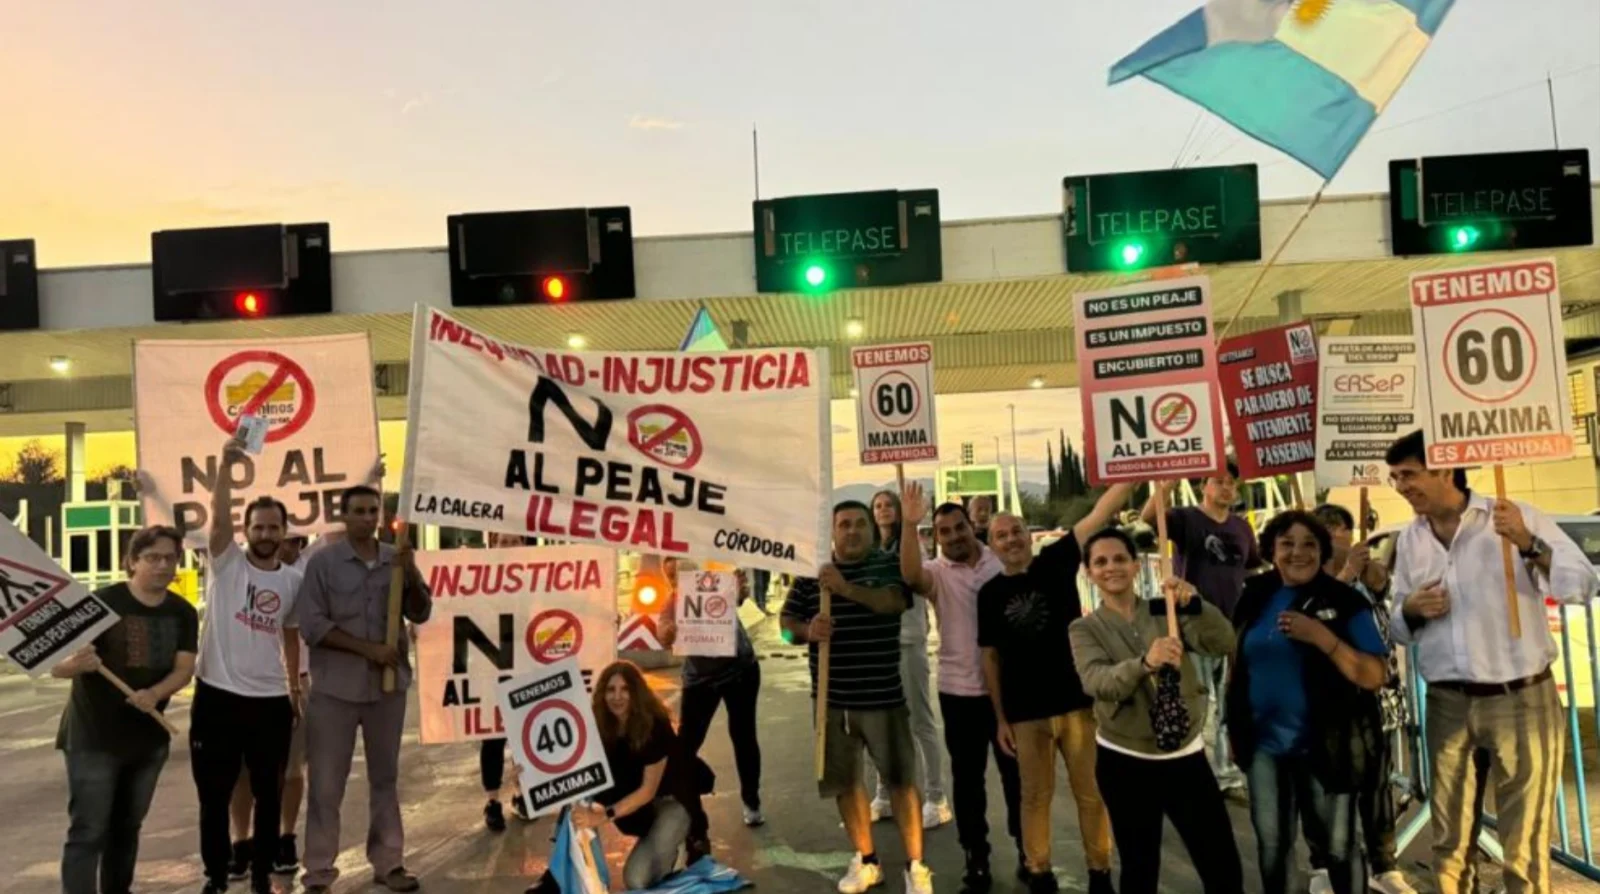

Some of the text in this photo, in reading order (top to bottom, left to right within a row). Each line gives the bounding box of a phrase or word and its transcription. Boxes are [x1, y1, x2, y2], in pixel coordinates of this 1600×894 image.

[1430, 187, 1553, 216] TELEPASE
[1096, 206, 1217, 236] TELEPASE
[780, 226, 896, 255] TELEPASE
[1415, 266, 1551, 302] TENEMOS
[1088, 290, 1197, 314] NO ES UN PEAJE
[1089, 321, 1201, 344] ES UN IMPUESTO
[855, 347, 929, 365] TENEMOS
[1098, 354, 1183, 374] ENCUBIERTO
[1456, 326, 1524, 386] 60
[1240, 362, 1293, 390] SE BUSCA
[1334, 374, 1405, 393] ERSeP
[877, 382, 913, 416] 60
[1234, 385, 1314, 416] PARADERO DE
[1246, 412, 1313, 441] INTENDENTE
[1440, 405, 1552, 438] MAXIMA
[868, 429, 928, 447] MAXIMA
[1112, 437, 1203, 458] AL PEAJE
[864, 451, 879, 462] ES
[1433, 445, 1459, 462] ES
[181, 447, 347, 493] NO AL
[505, 449, 727, 515] AL PEAJE
[414, 493, 504, 521] LA CALERA
[526, 495, 689, 553] ILEGAL
[714, 528, 796, 561] CÓRDOBA
[429, 560, 602, 597] INJUSTICIA
[17, 599, 62, 632] TENEMOS
[15, 600, 102, 663] CRUCES PEATONALES
[442, 678, 481, 707] AL
[512, 675, 566, 703] TENEMOS
[536, 716, 573, 754] 40
